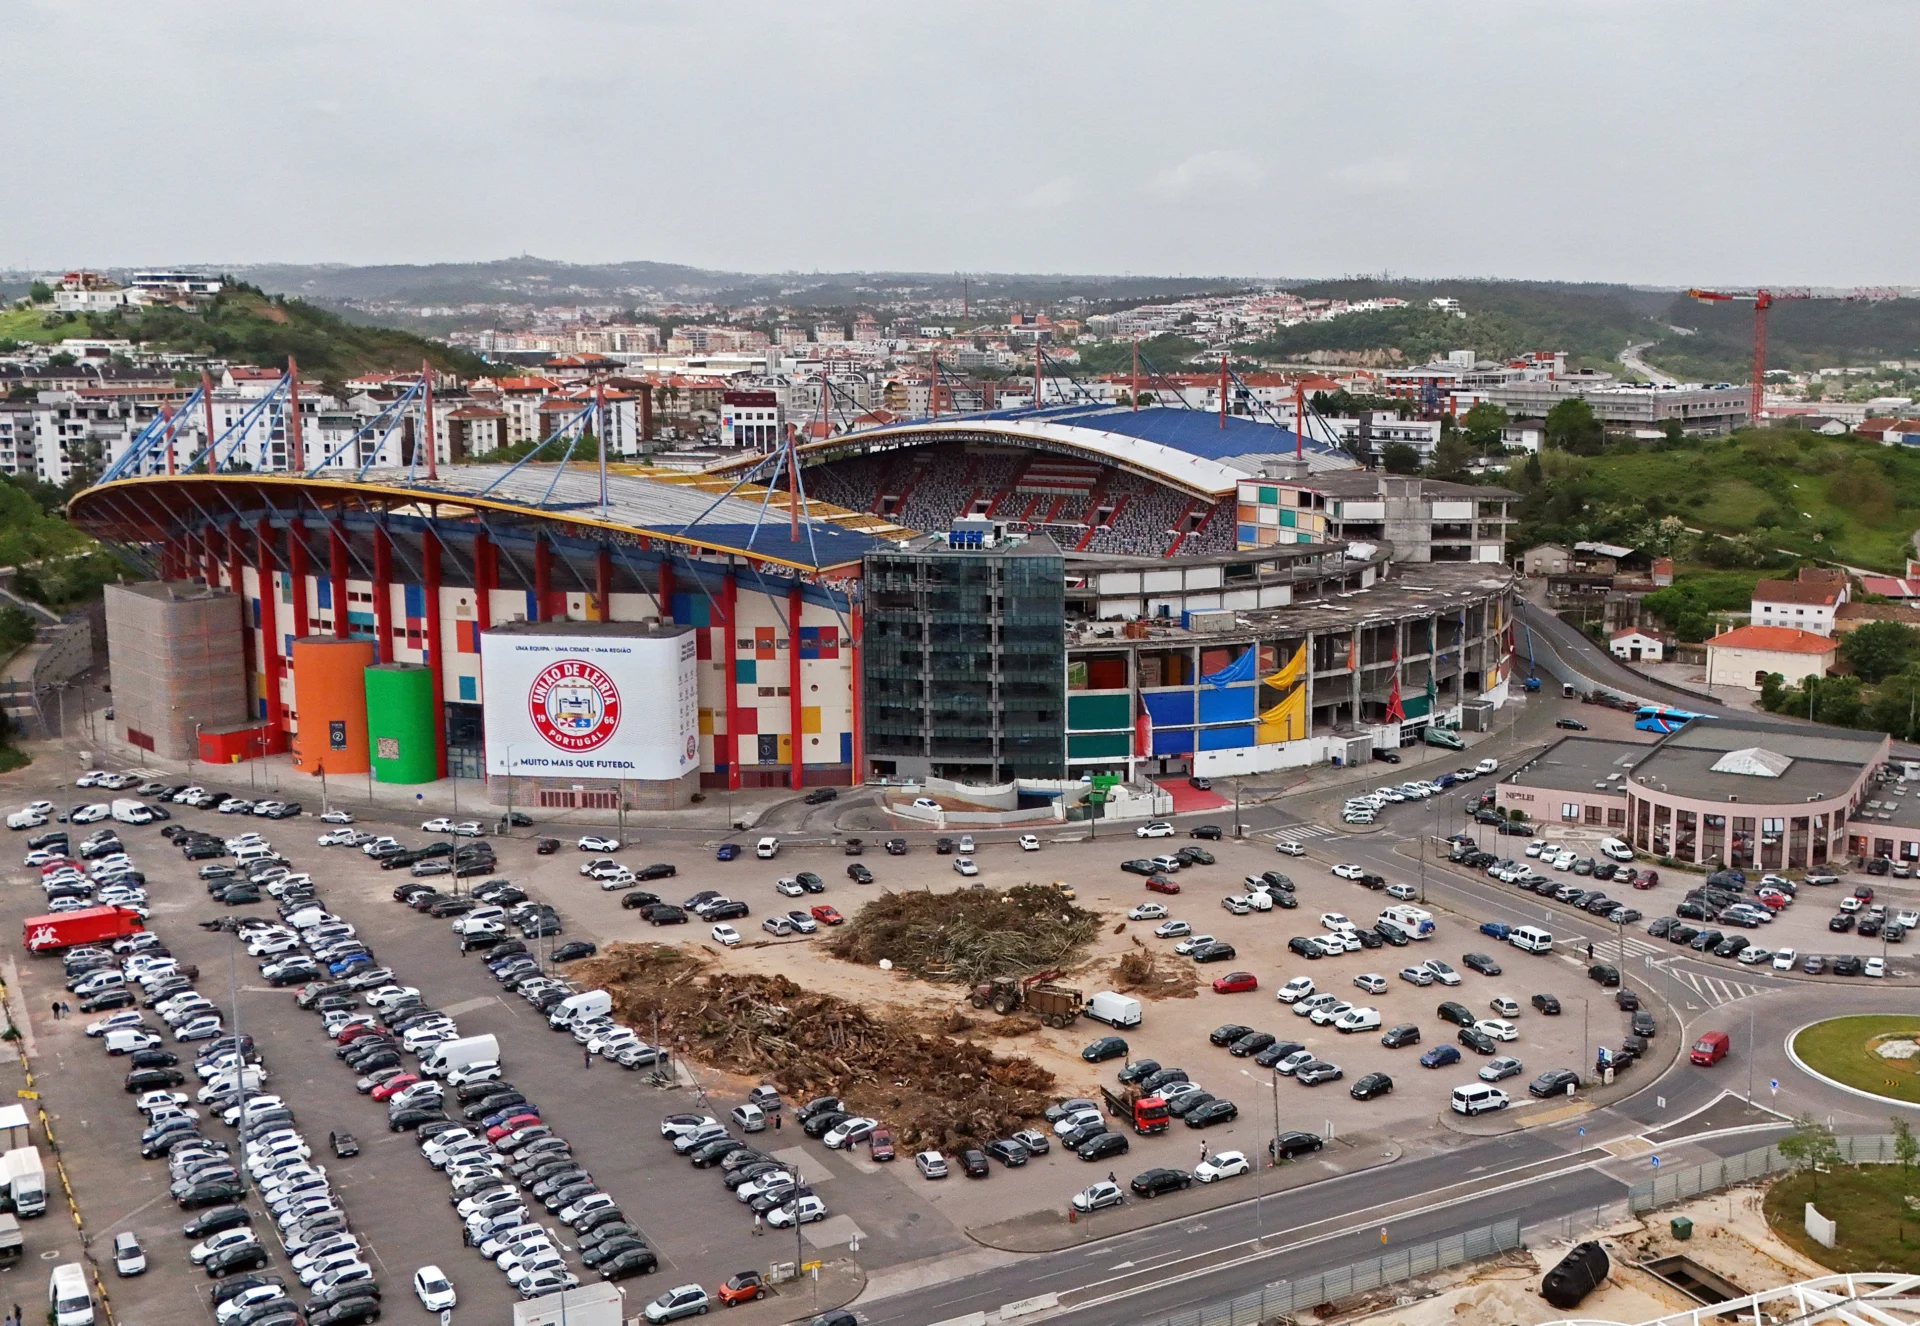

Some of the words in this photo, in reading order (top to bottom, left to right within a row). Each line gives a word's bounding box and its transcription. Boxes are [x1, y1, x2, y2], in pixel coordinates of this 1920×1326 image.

[864, 437, 906, 447] TRABALHO
[1046, 445, 1082, 457] MICHAEL
[1084, 453, 1113, 465] PHELPS
[533, 668, 561, 704] UNIÃO
[563, 664, 580, 676] DE
[583, 667, 616, 705] LEIRIA
[536, 714, 546, 722] 19
[604, 716, 615, 724] 66
[548, 729, 604, 747] PORTUGAL
[520, 758, 549, 766] MUITO
[551, 759, 574, 767] MAIS
[576, 760, 594, 768] QUE
[597, 760, 635, 769] FUTEBOL
[1505, 792, 1535, 801] NERLEI
